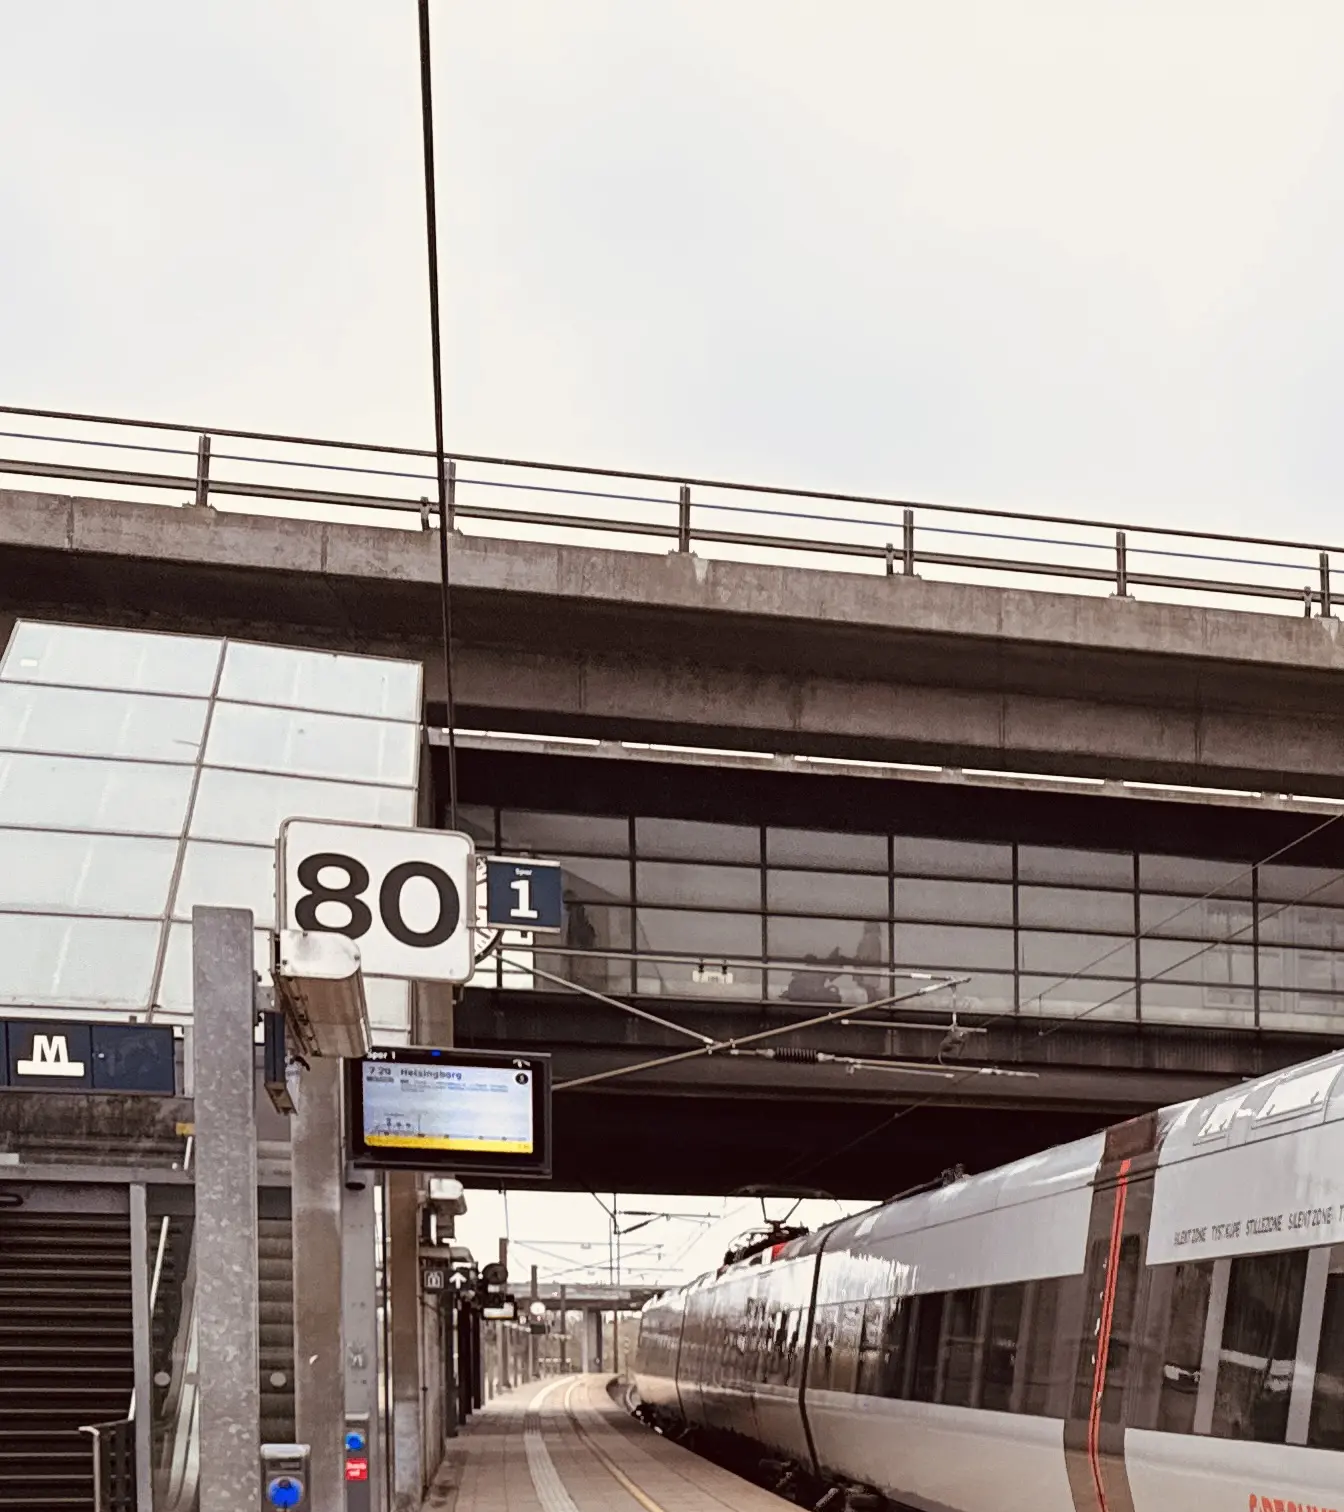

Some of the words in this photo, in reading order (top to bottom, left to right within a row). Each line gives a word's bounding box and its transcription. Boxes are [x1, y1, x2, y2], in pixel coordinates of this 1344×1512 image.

[295, 853, 460, 948] 80
[510, 879, 538, 919] 1
[400, 1068, 462, 1081] Helsingborg
